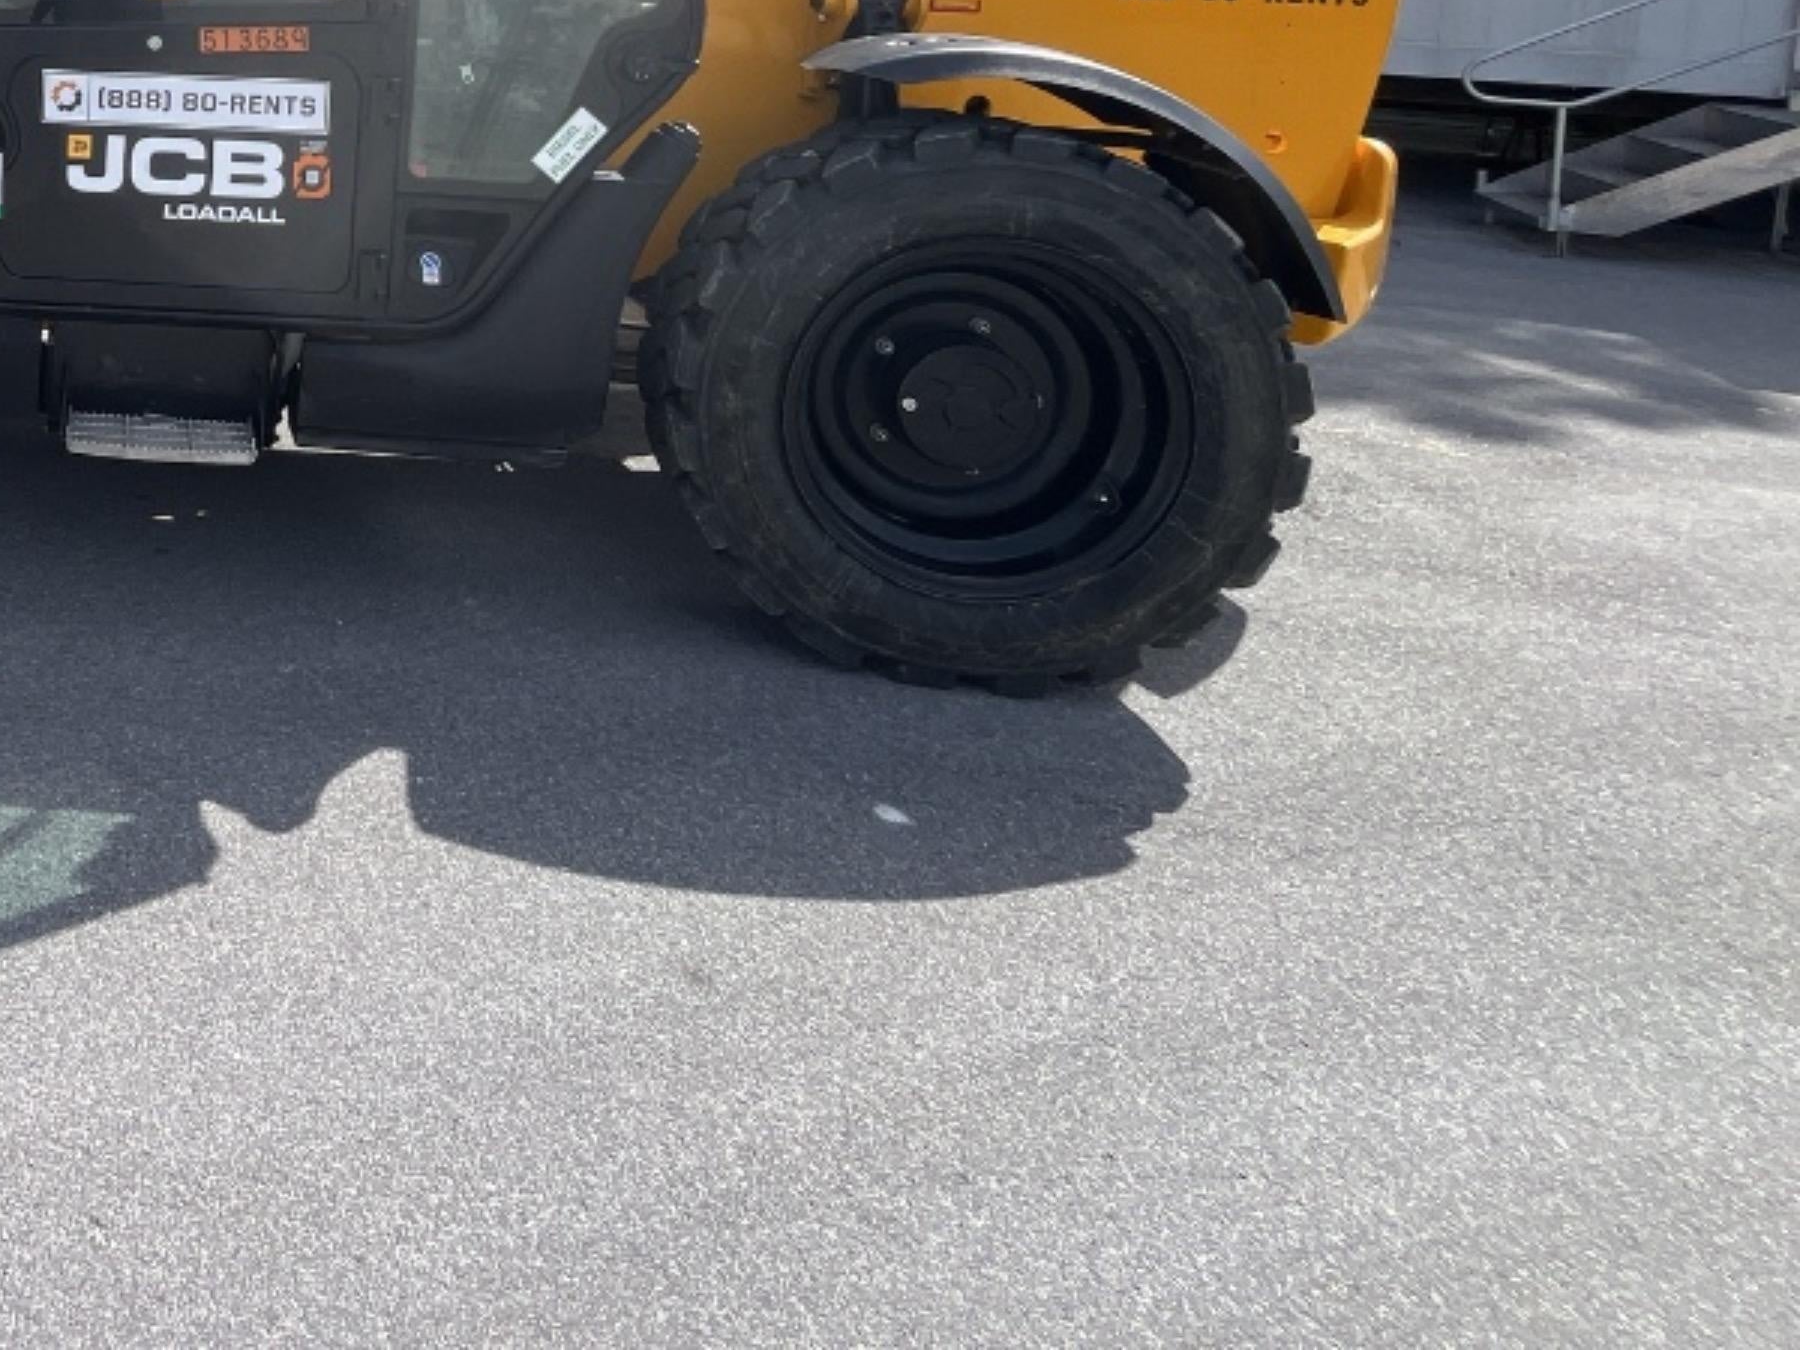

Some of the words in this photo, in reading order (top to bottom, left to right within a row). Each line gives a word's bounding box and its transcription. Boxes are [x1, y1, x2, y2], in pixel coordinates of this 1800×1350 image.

[98, 87, 172, 113] (888)
[182, 91, 317, 117] 80-RENTS
[65, 134, 285, 199] JCB
[163, 203, 287, 225] LOADALL
